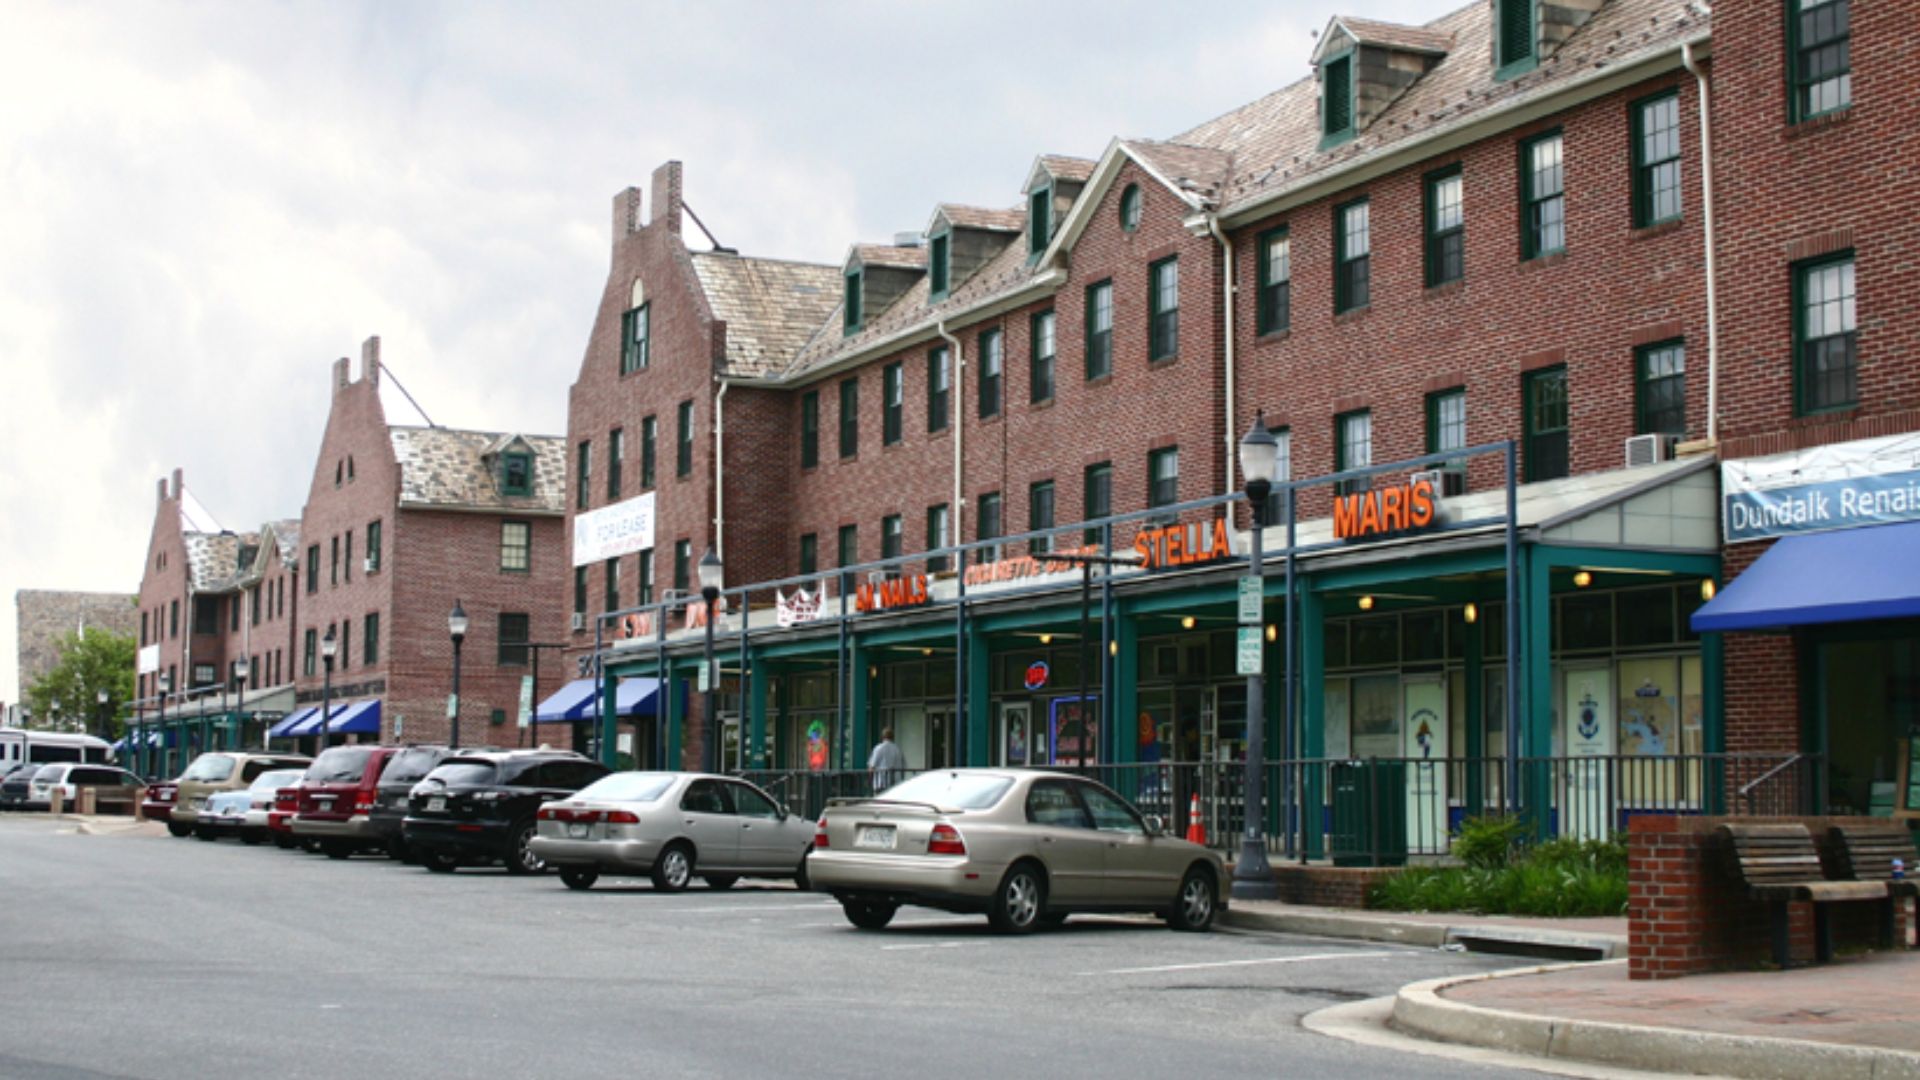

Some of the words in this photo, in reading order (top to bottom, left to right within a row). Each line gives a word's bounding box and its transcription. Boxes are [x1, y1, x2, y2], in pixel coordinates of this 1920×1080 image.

[1333, 480, 1434, 539] MARIS
[1732, 491, 1830, 531] Dundalk
[1839, 480, 1920, 519] Renai
[1134, 517, 1231, 569] STELLA
[879, 575, 927, 609] NAILS
